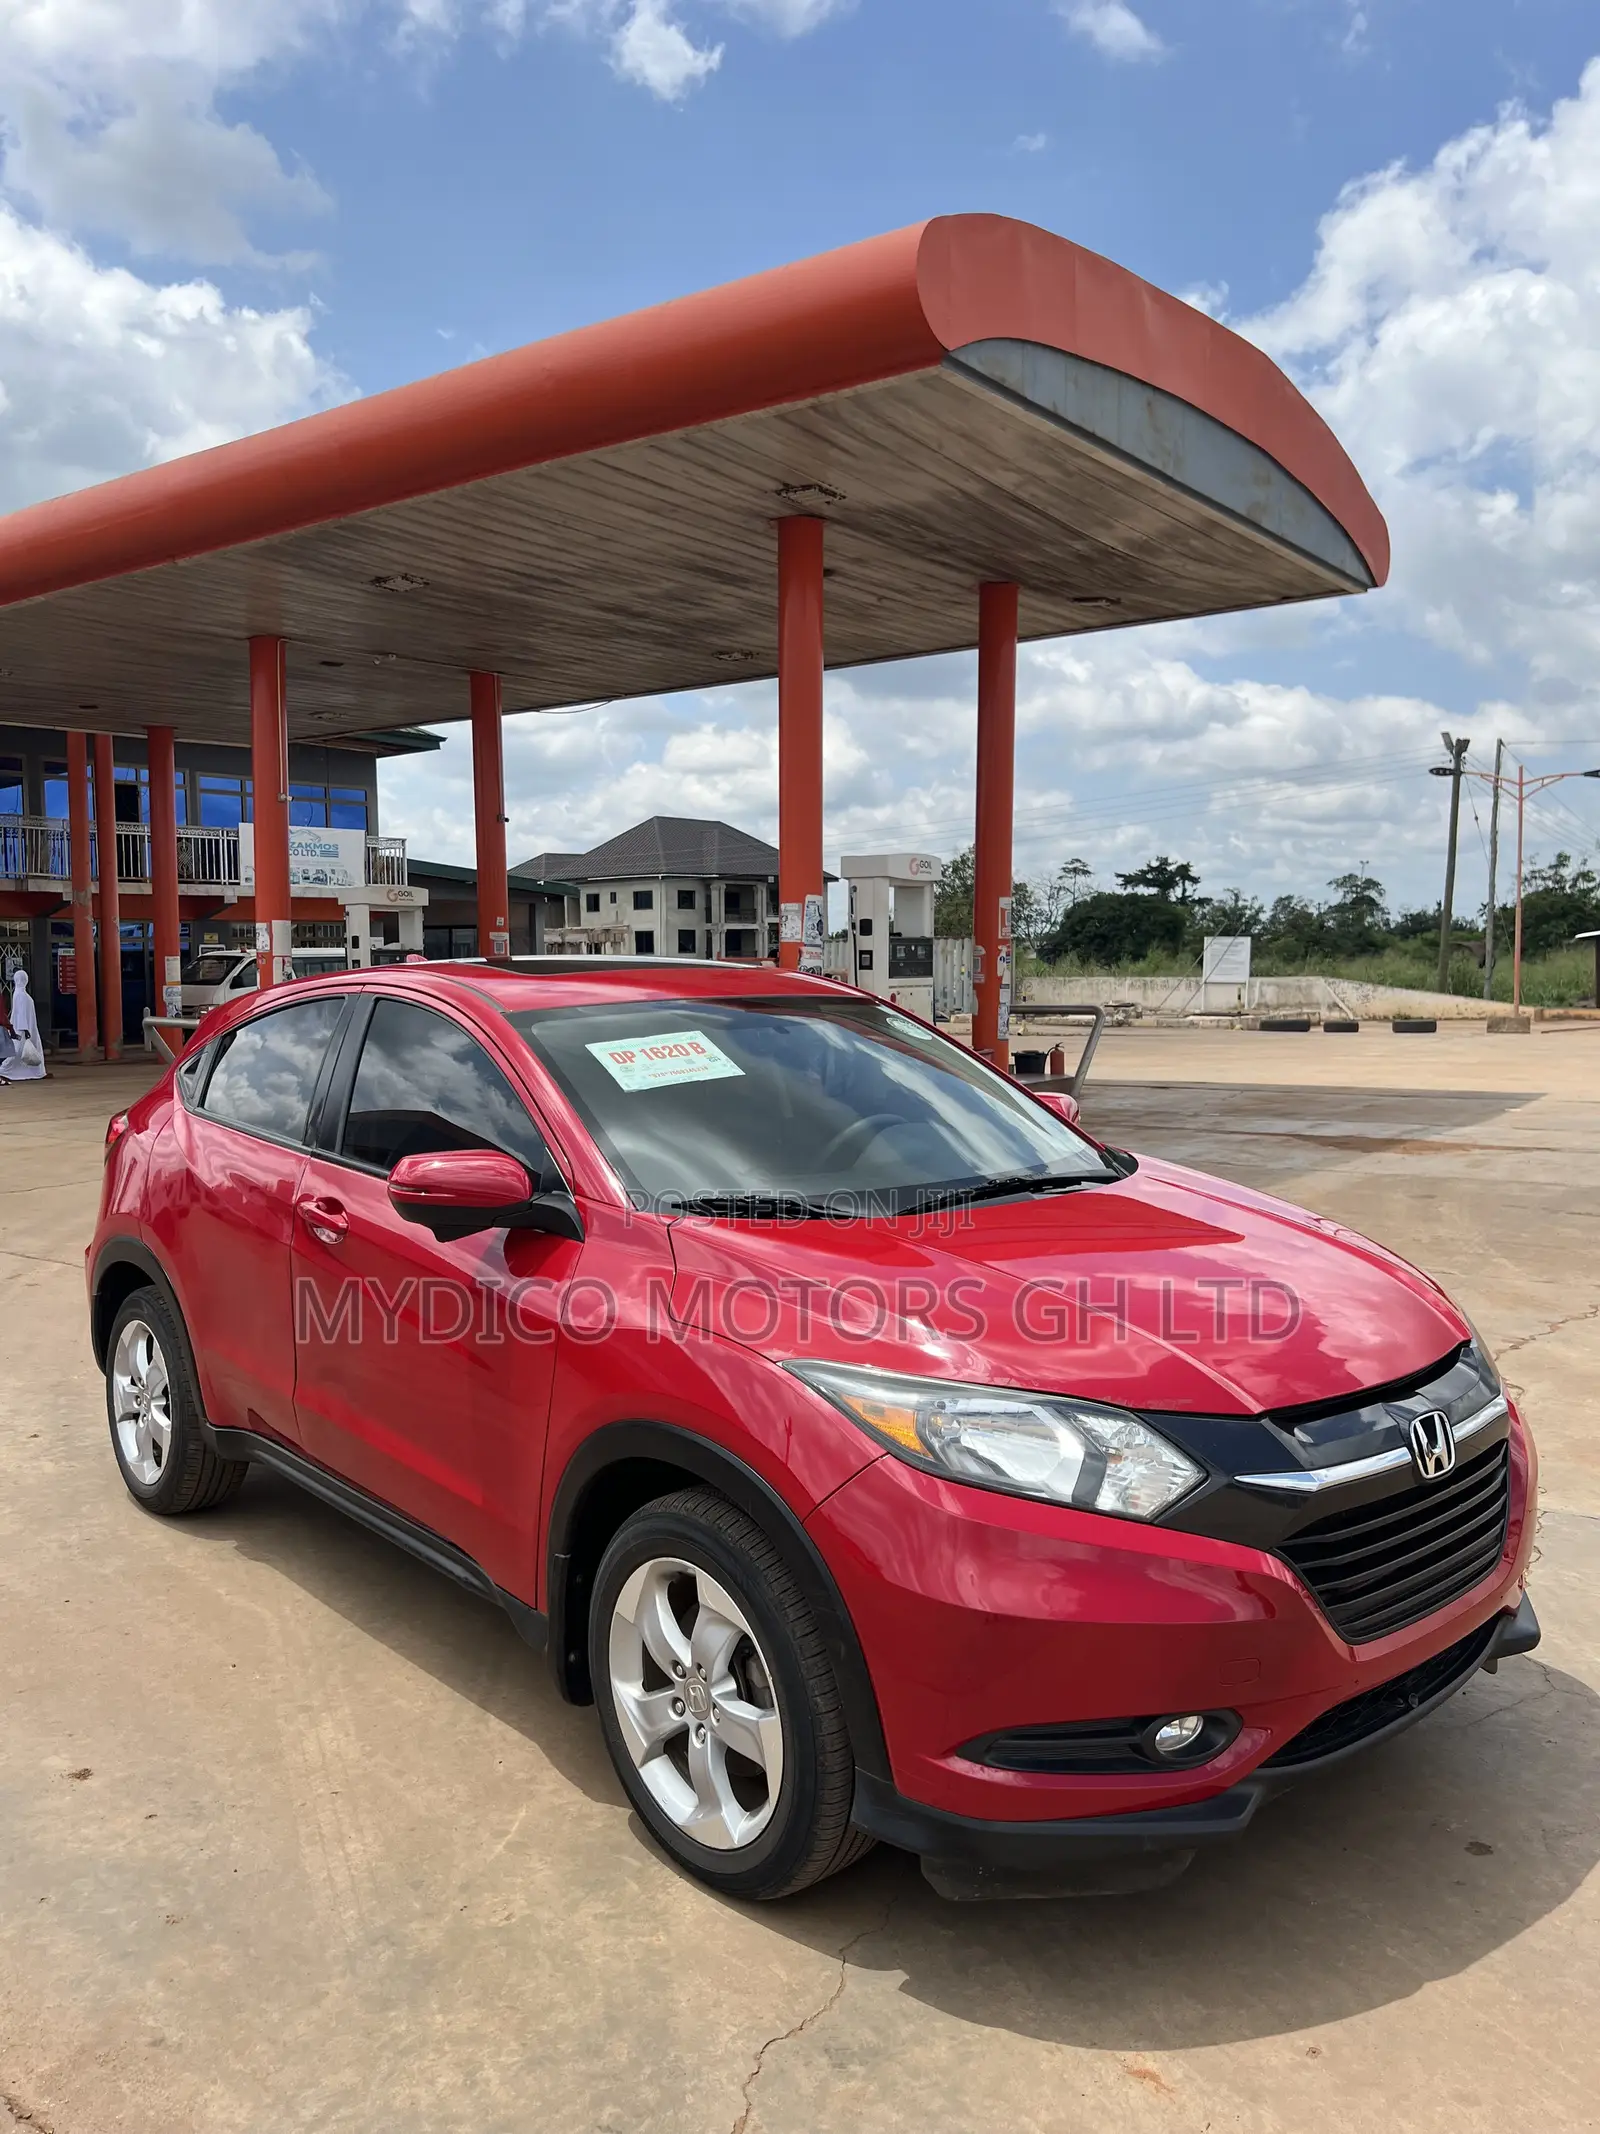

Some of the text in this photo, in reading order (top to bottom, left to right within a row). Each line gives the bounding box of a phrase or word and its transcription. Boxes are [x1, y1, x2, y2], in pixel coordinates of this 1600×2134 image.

[608, 1050, 636, 1064] DP
[639, 1044, 690, 1061] 1620
[688, 1042, 707, 1055] B
